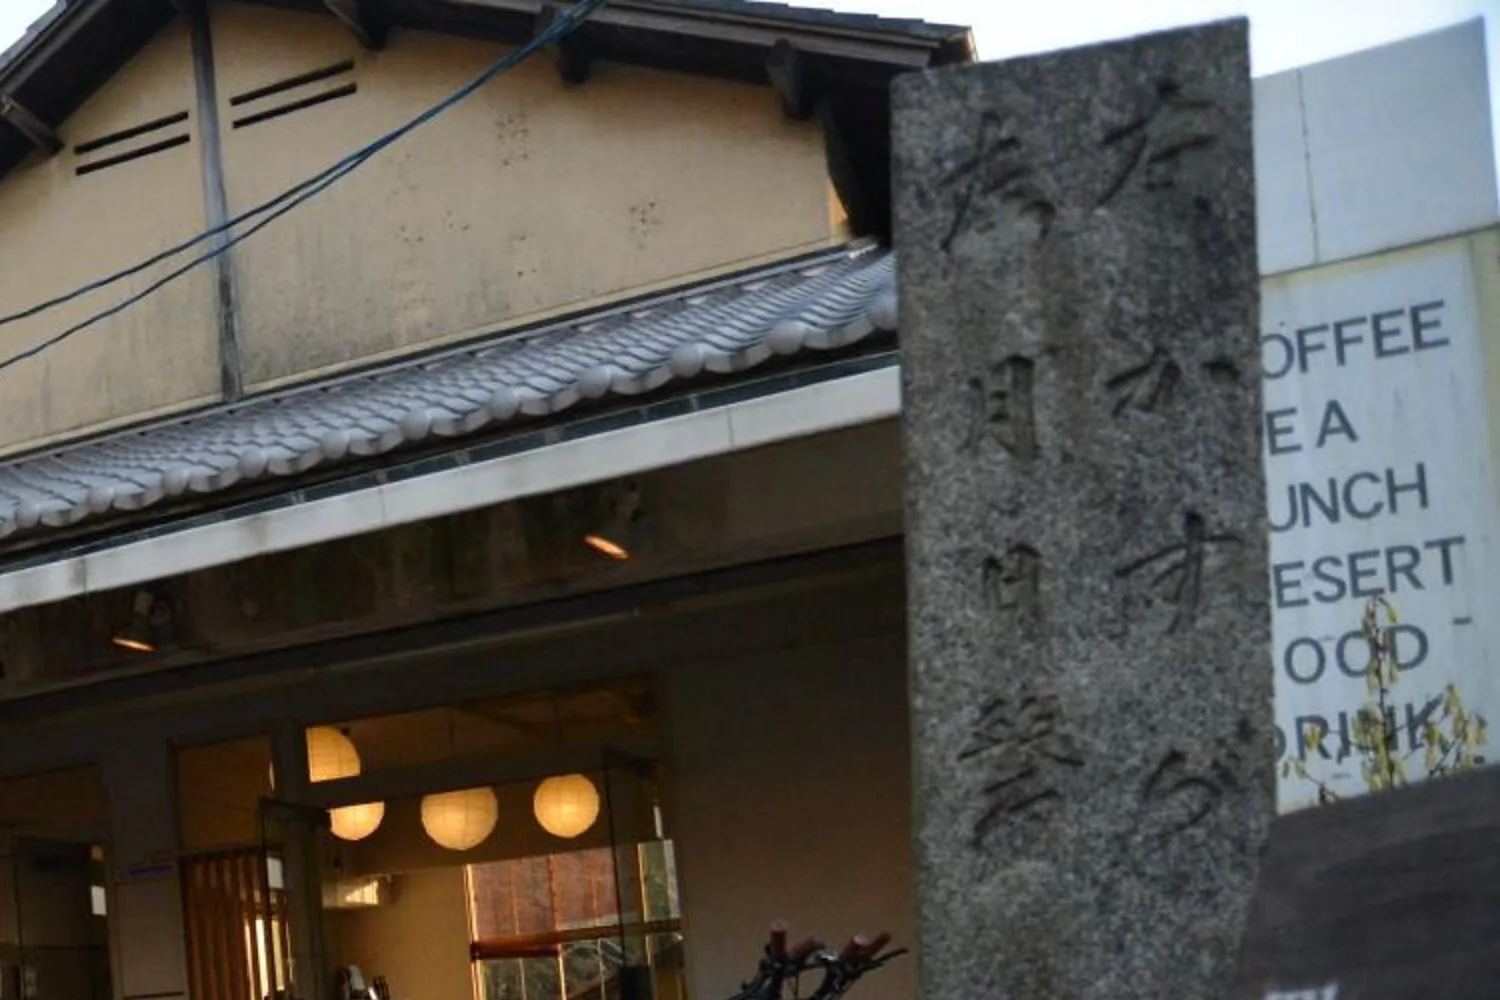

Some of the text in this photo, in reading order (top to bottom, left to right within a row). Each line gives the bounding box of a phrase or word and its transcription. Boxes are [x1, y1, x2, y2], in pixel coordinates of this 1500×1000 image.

[1261, 299, 1450, 380] OFFEE
[1266, 399, 1358, 456] EA
[1269, 463, 1429, 533] UNCH
[1274, 536, 1465, 609] ESERT
[1283, 624, 1429, 685] OOD
[1274, 692, 1448, 763] RINK
